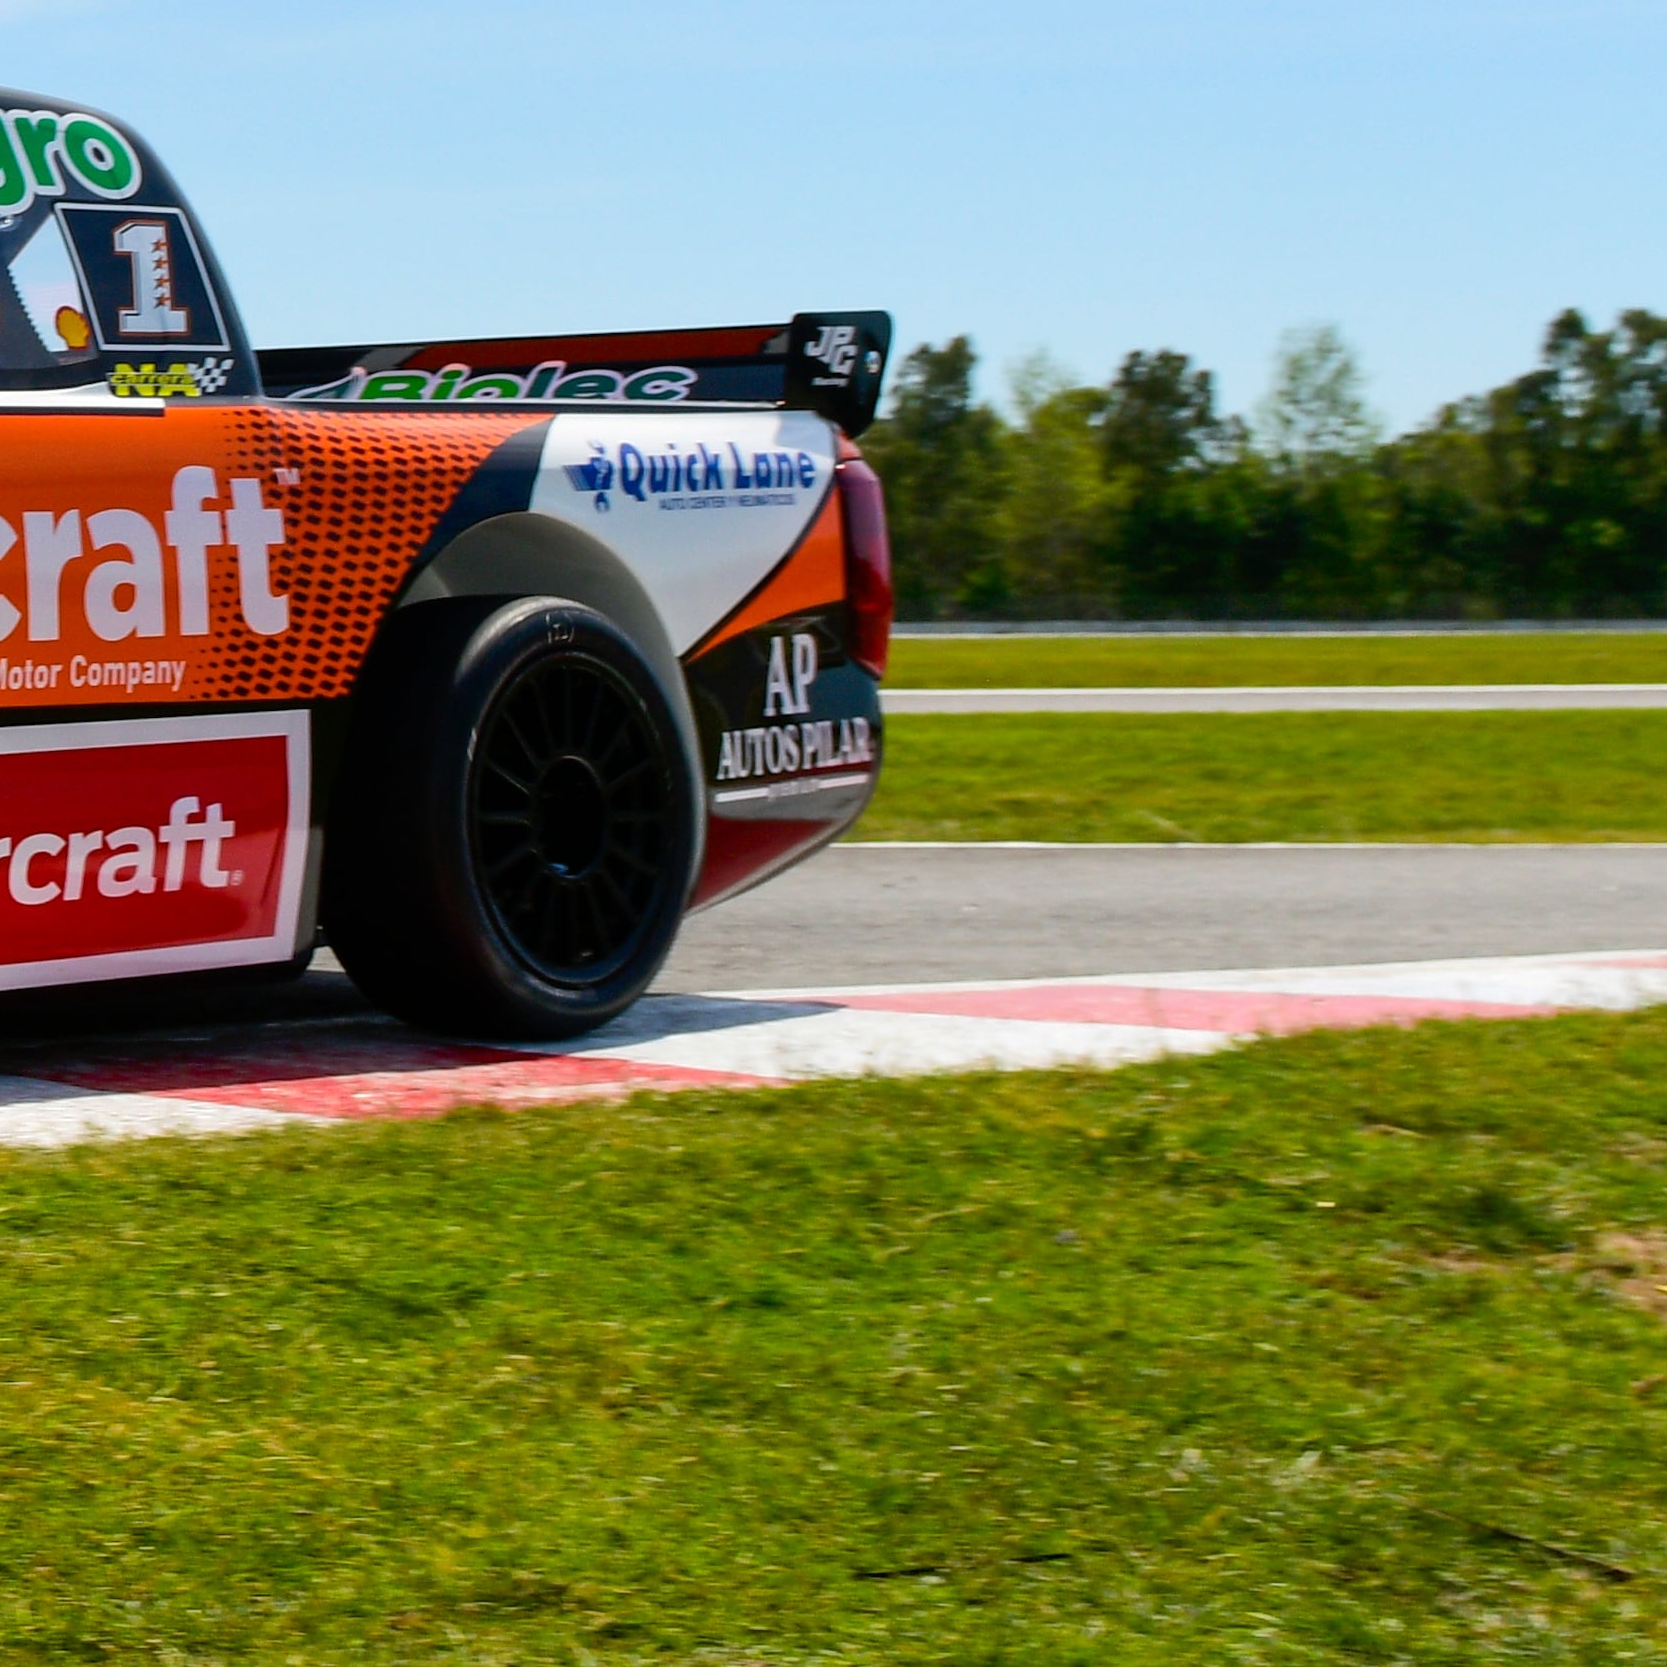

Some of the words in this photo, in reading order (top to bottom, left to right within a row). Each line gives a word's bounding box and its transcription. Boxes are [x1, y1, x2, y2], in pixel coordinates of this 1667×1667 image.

[113, 218, 191, 337] 1
[359, 361, 697, 402] Biolec
[619, 441, 723, 502] Quick
[727, 441, 816, 489] Lane
[69, 654, 186, 692] Company
[762, 633, 817, 717] AP
[715, 723, 801, 781] AUTOS
[800, 716, 875, 771] PILAR
